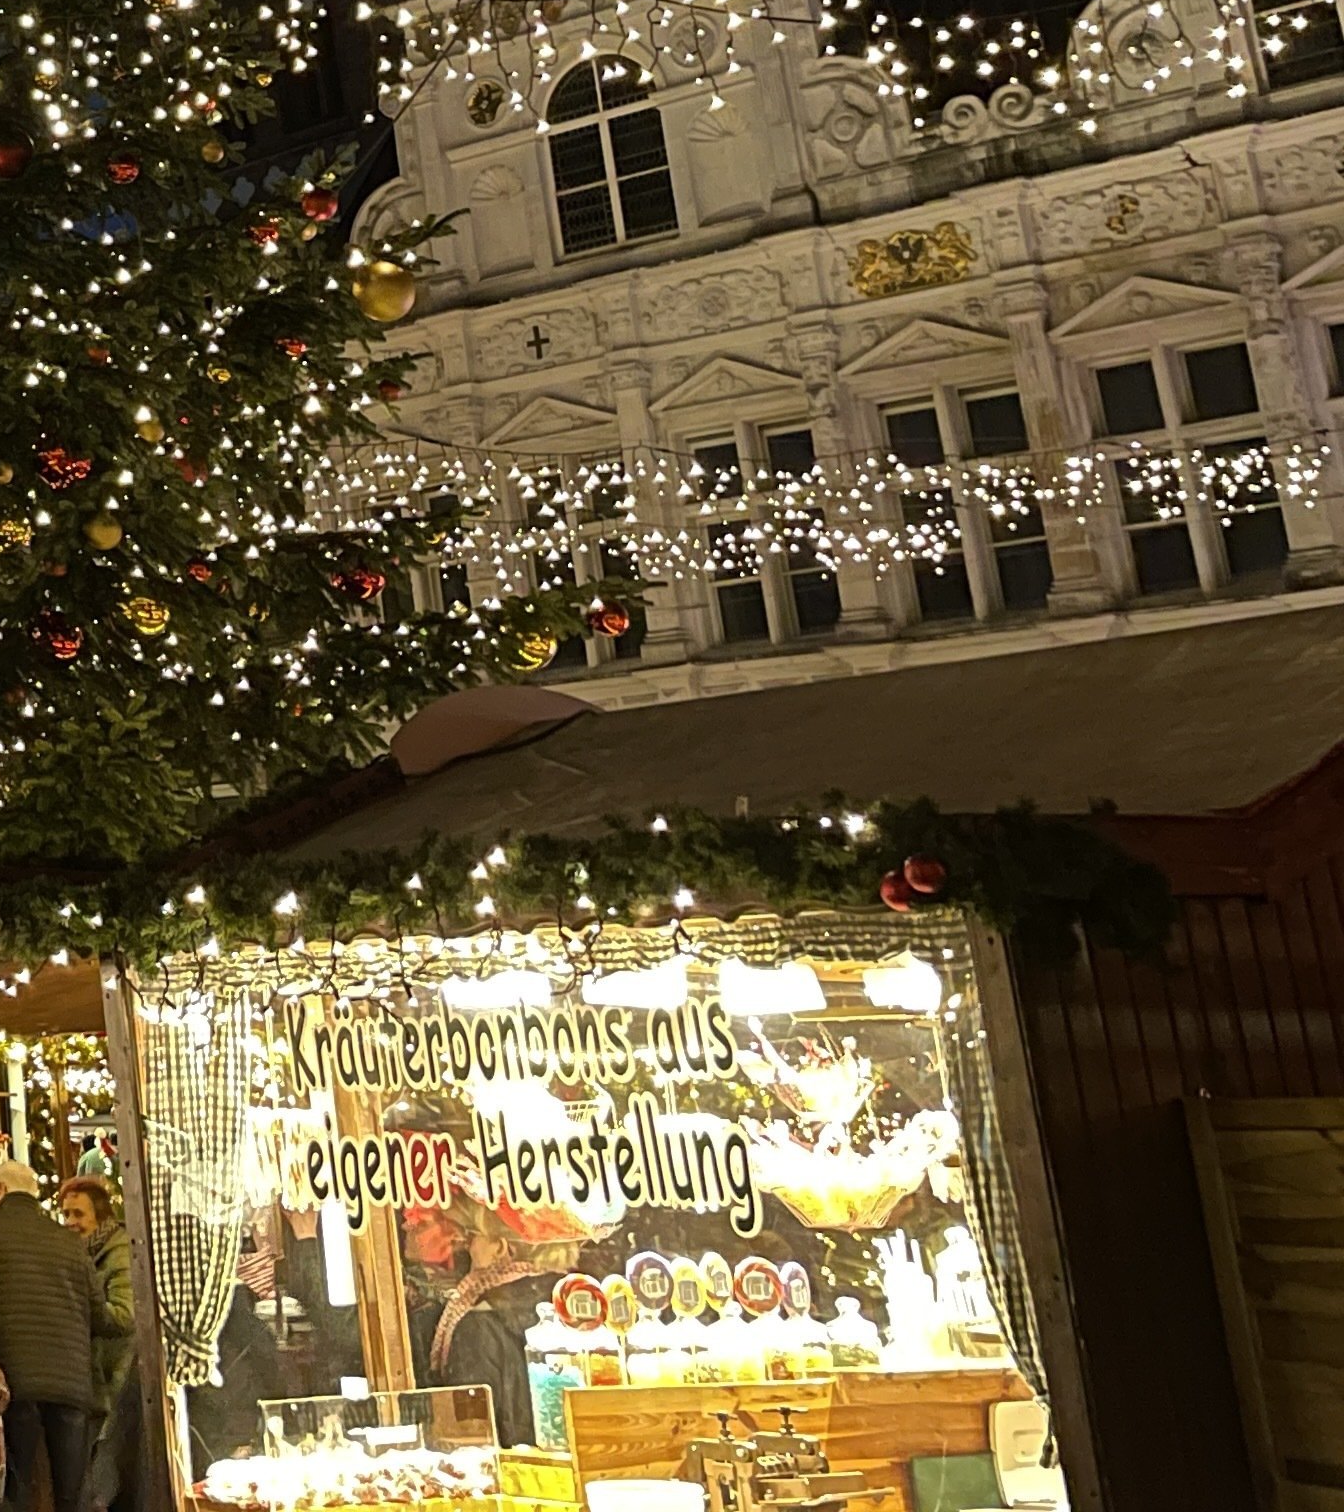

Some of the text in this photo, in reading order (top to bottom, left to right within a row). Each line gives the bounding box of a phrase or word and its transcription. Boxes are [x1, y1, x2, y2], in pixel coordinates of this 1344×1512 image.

[284, 989, 736, 1092] Kräuterbonbons aus
[306, 1098, 758, 1233] eigener Herstellung
